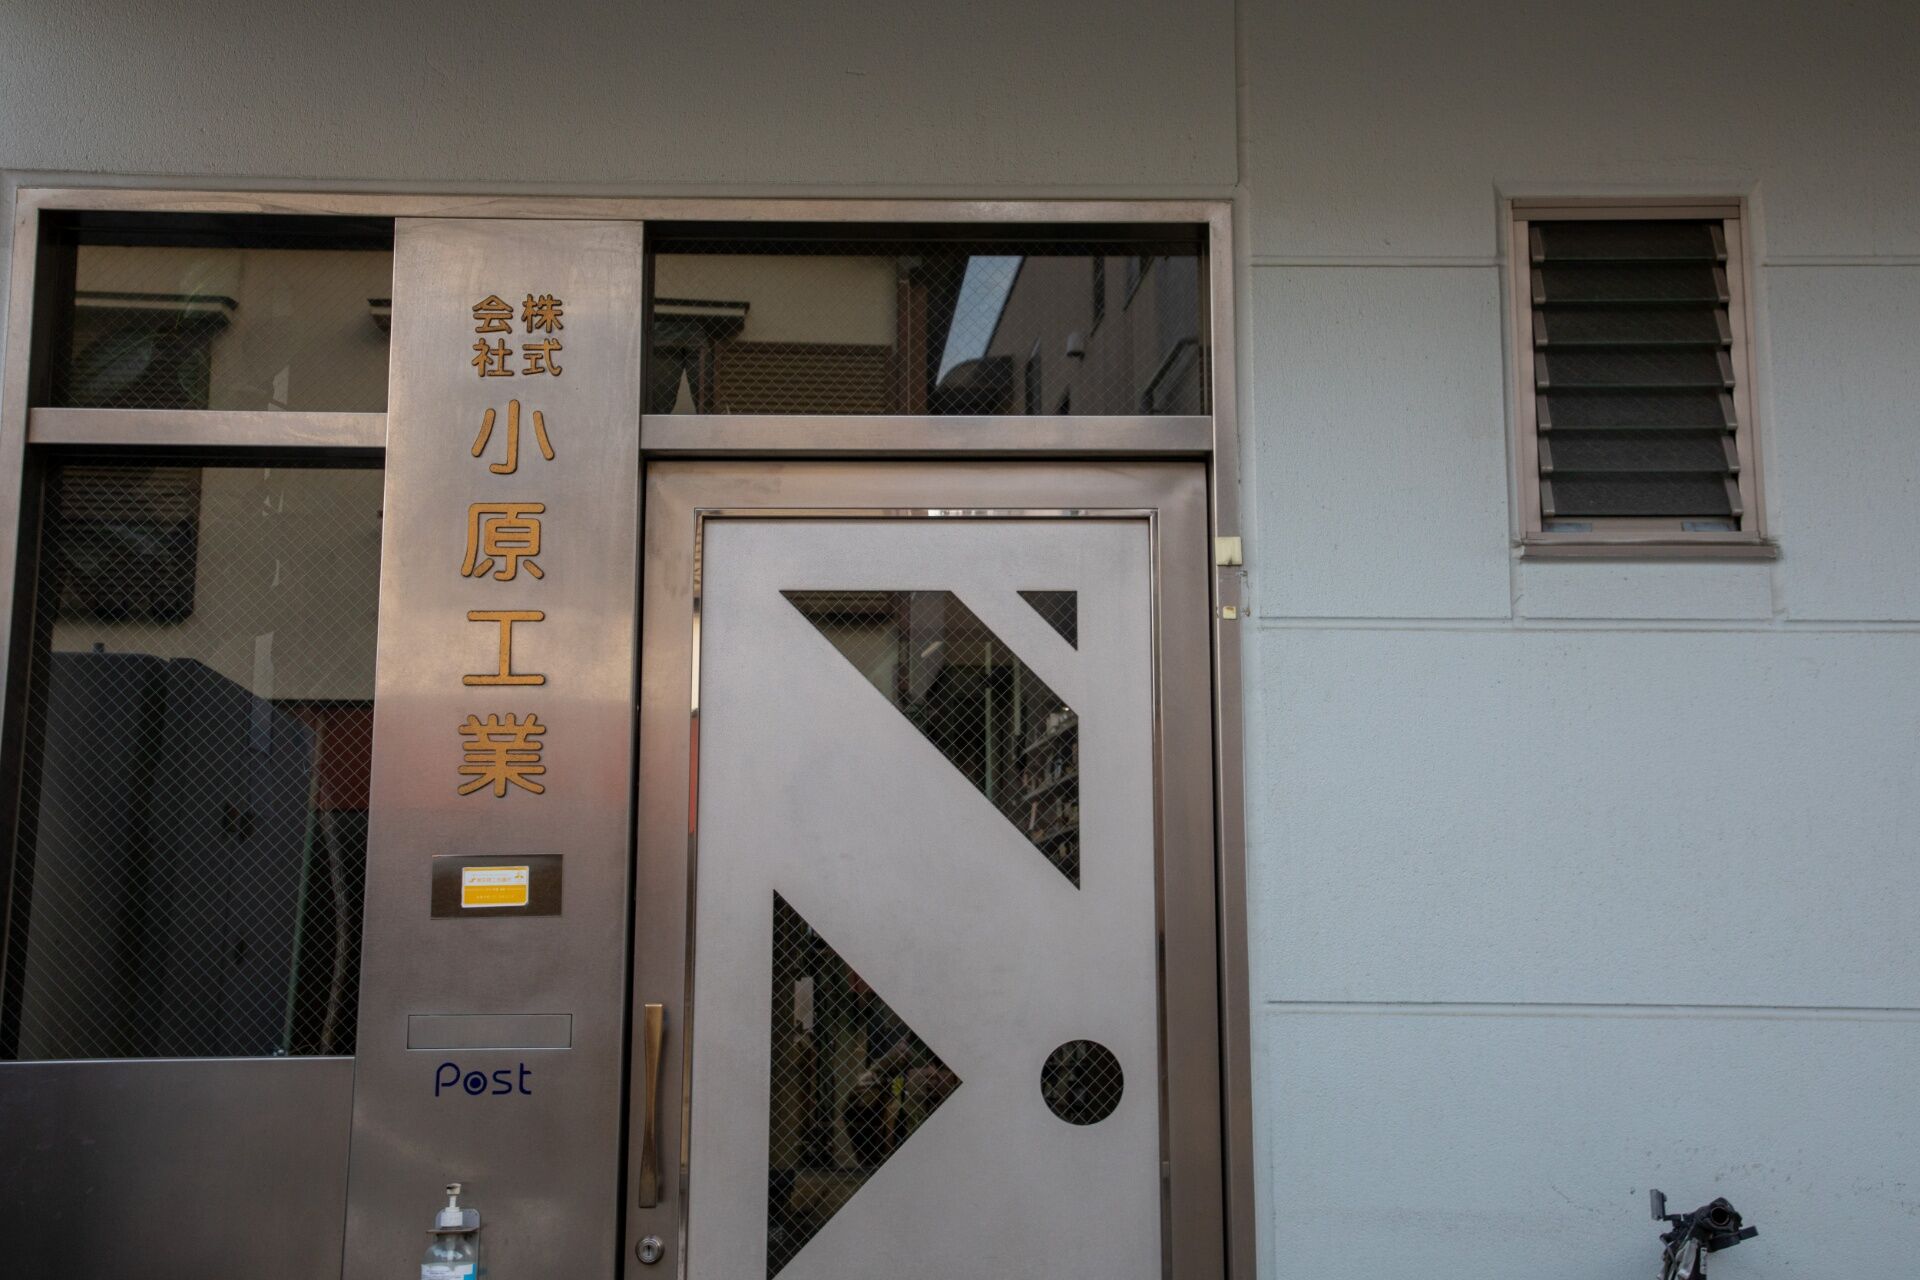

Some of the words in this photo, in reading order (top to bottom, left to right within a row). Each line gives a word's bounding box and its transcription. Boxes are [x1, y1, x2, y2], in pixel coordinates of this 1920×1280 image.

[472, 294, 514, 377] 会社
[521, 293, 564, 376] 株式
[457, 399, 556, 798] 小原工業
[435, 1062, 532, 1097] Post
